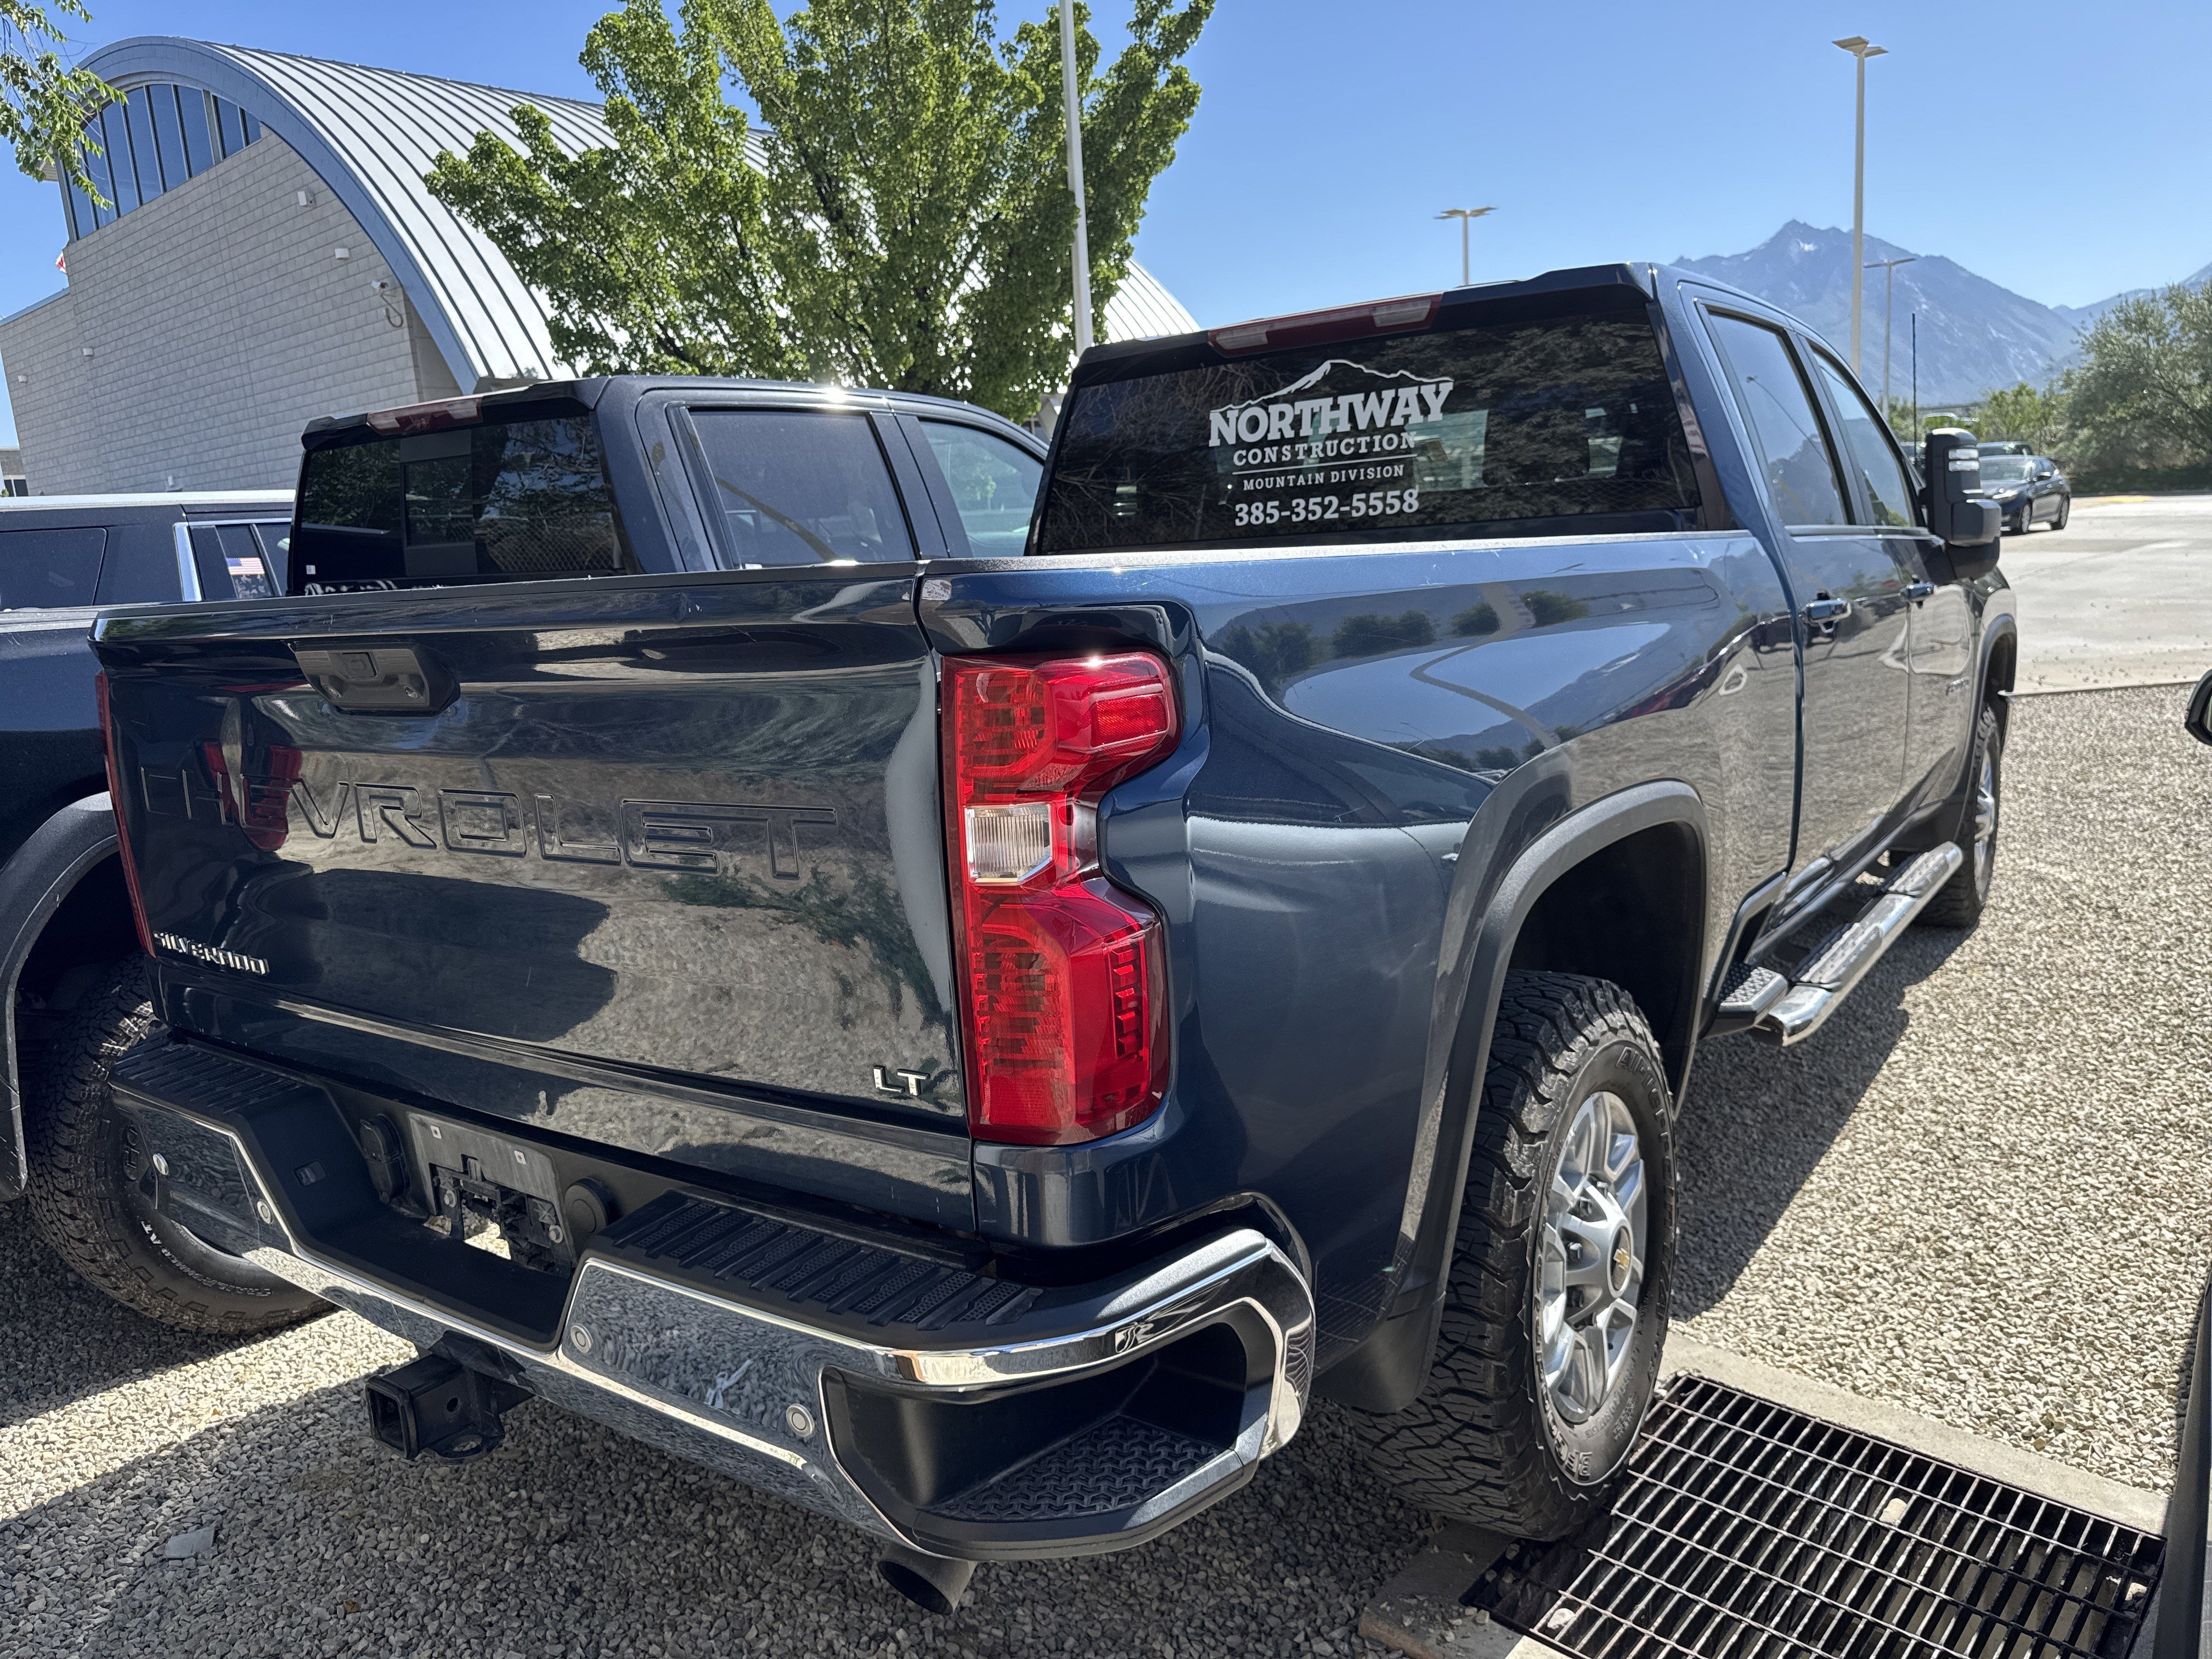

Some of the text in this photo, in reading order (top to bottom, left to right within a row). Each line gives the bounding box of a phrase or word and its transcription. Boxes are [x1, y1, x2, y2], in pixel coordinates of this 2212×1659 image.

[1209, 382, 1454, 447] NORTHWAY
[1233, 431, 1417, 466] CONSTRUCTION
[1243, 465, 1404, 491] MOUNTAIN DIVISION
[1234, 489, 1419, 526] 385-352-5558
[140, 765, 838, 879] CHEVROLET
[154, 931, 270, 976] SILVERADO
[873, 1064, 931, 1097] LT
[140, 1220, 162, 1245] AT
